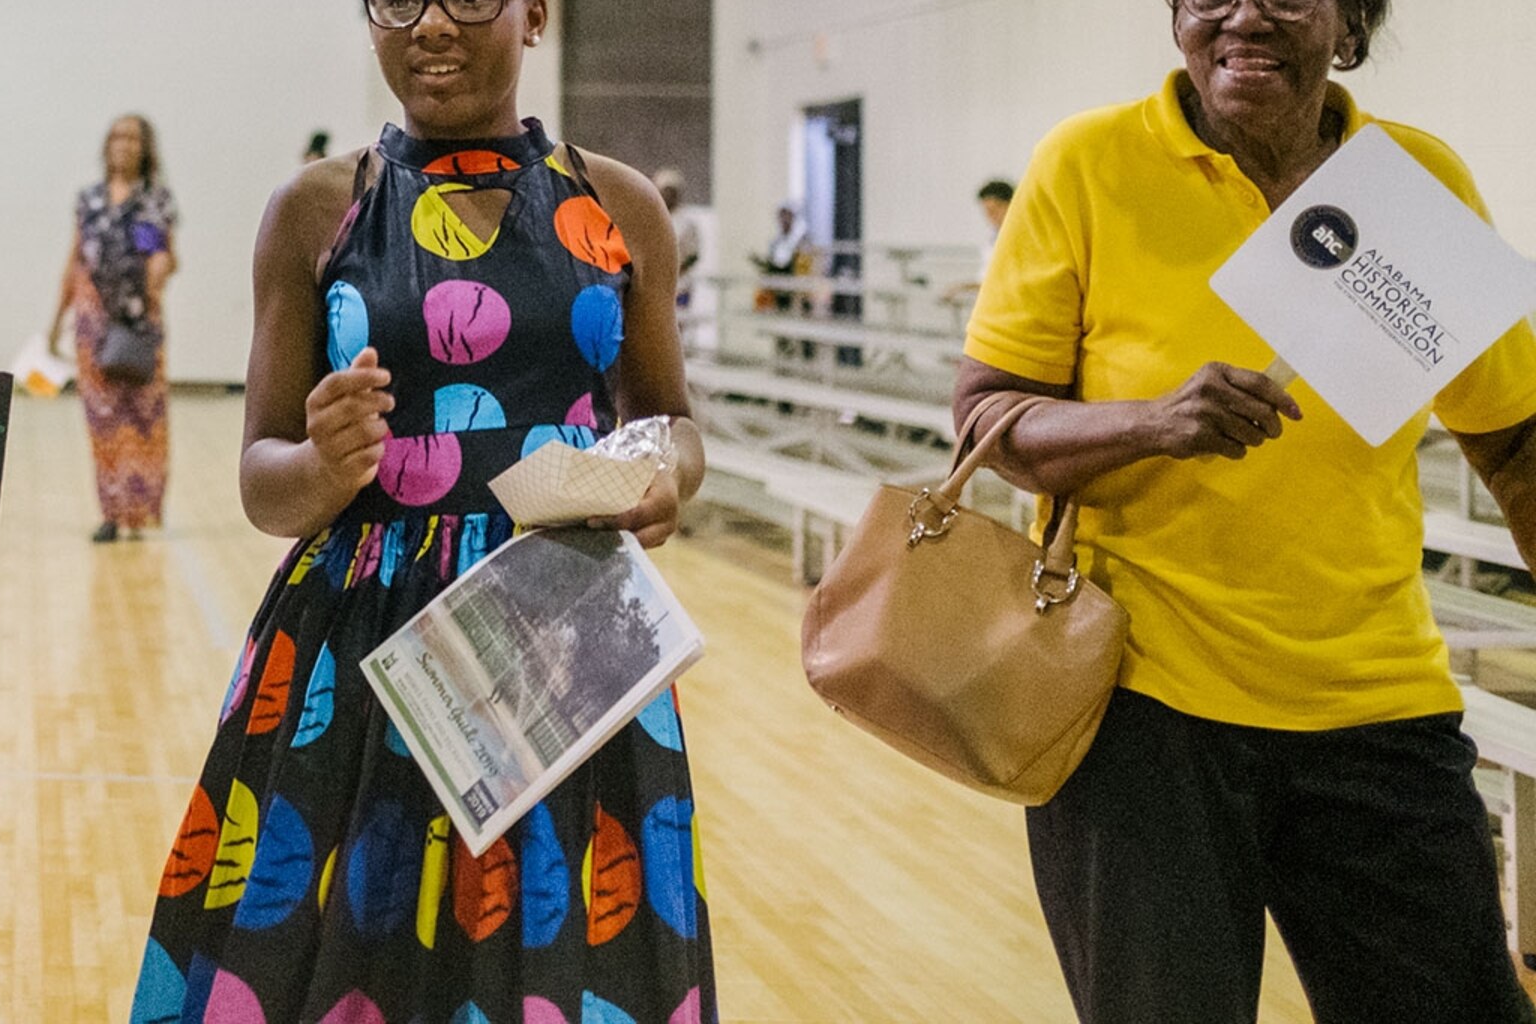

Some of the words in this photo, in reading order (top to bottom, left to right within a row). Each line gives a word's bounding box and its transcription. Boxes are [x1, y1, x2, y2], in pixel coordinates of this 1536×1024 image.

[1313, 225, 1343, 255] ahc
[1365, 249, 1433, 311] ALABAMA
[1341, 268, 1444, 365] COMMISSION
[1351, 256, 1445, 347] HISTORICAL
[415, 651, 455, 709] Summer
[447, 706, 479, 745] Guide
[473, 743, 501, 778] 2019
